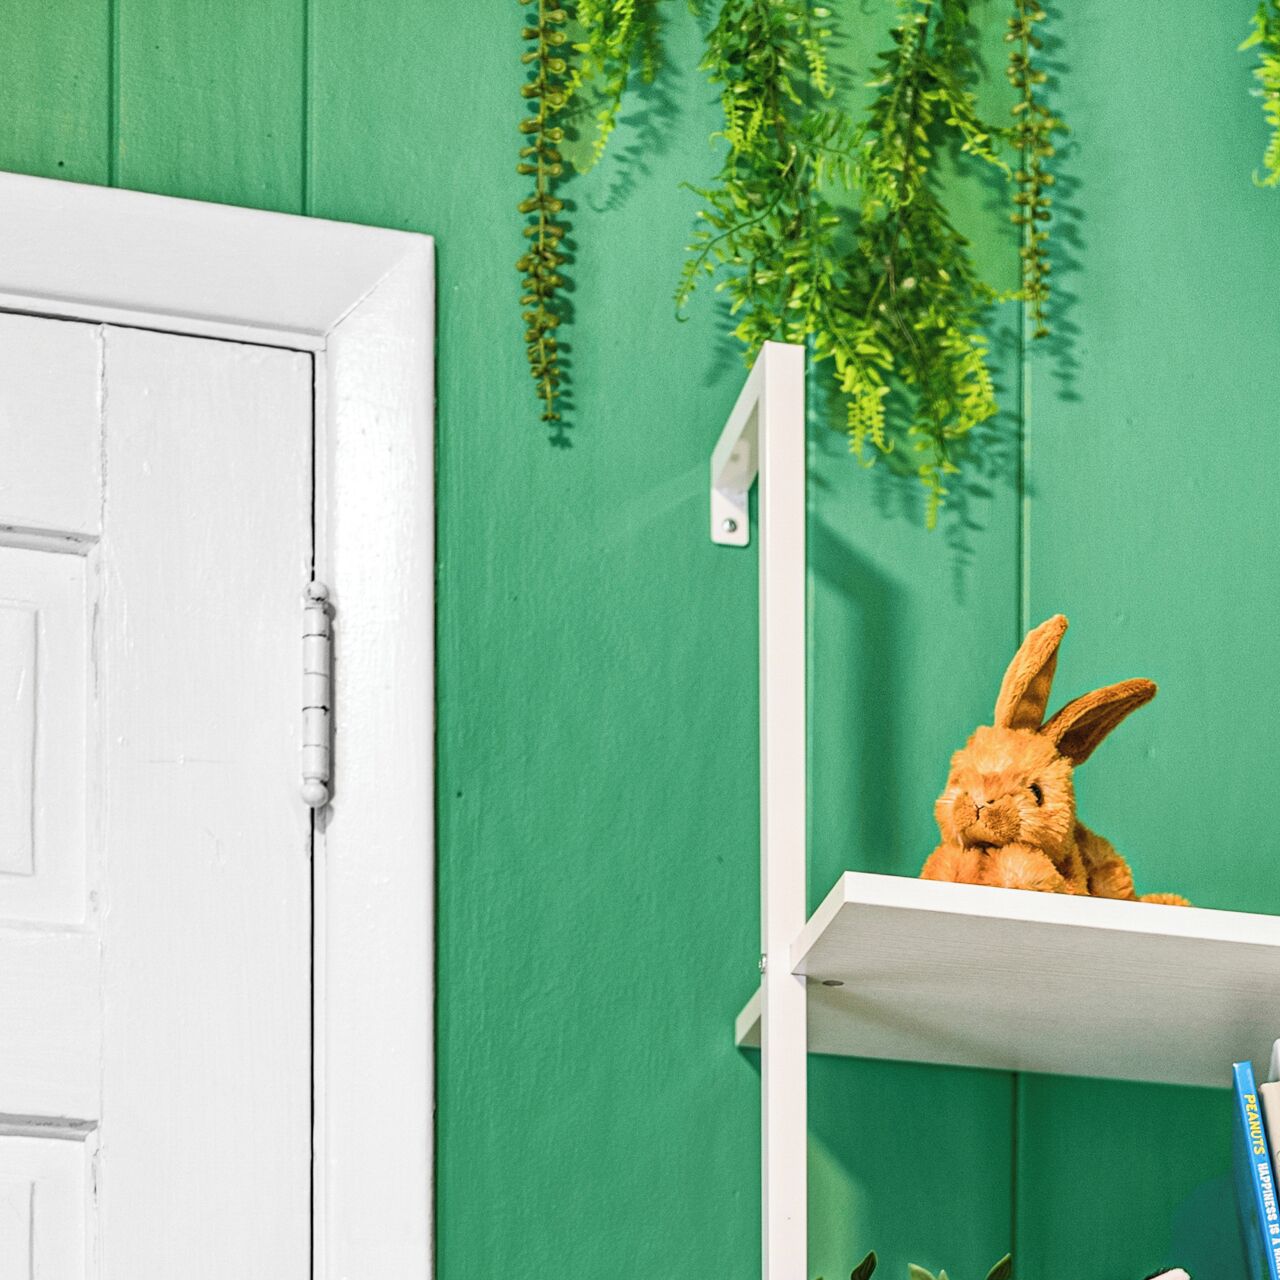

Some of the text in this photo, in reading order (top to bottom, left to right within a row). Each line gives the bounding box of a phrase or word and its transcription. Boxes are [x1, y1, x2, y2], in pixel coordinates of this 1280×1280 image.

[1243, 1093, 1265, 1155] PEANUTS
[1257, 1162, 1277, 1220] HAPPINESS
[1268, 1224, 1279, 1234] IS
